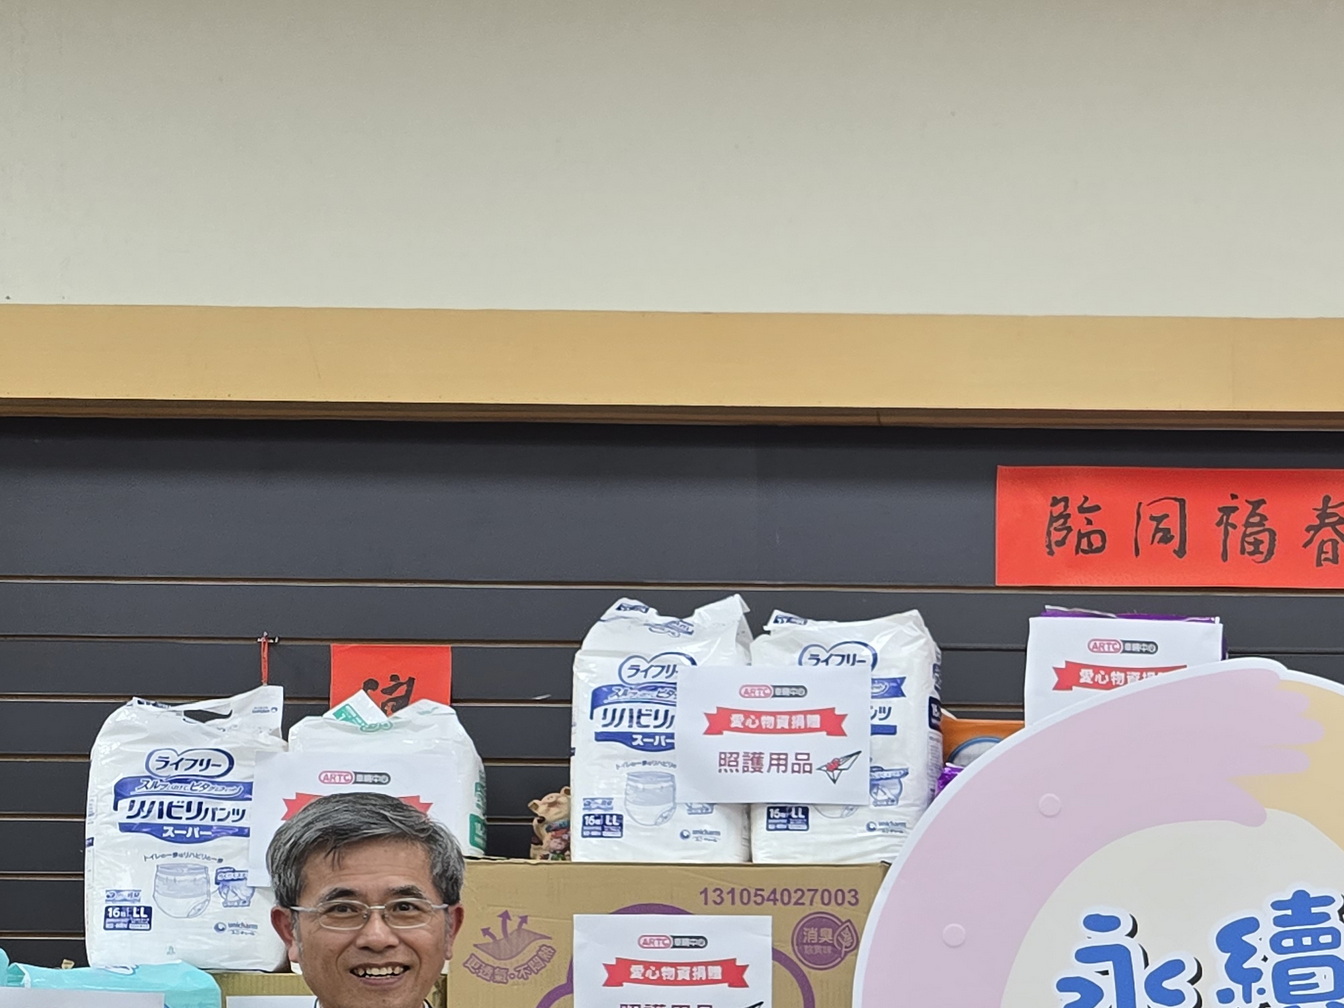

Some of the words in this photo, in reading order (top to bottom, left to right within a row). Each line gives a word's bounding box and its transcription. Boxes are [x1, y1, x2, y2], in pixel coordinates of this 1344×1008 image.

[1091, 641, 1120, 653] ARTC
[1079, 668, 1163, 686] 愛心物資
[742, 686, 770, 697] ARTC
[729, 713, 821, 730] 愛心物資捐贈
[154, 756, 223, 772] ライフリー
[717, 751, 814, 774] 照護用品
[323, 773, 351, 783] ARTC
[127, 799, 247, 823] リハビリパンツ
[162, 826, 213, 838] スーパー
[699, 887, 860, 907] 131054027003
[132, 906, 148, 918] LL
[642, 936, 670, 947] ARTC
[803, 927, 834, 945] 消臭
[628, 964, 723, 981] 愛心物資捐贈
